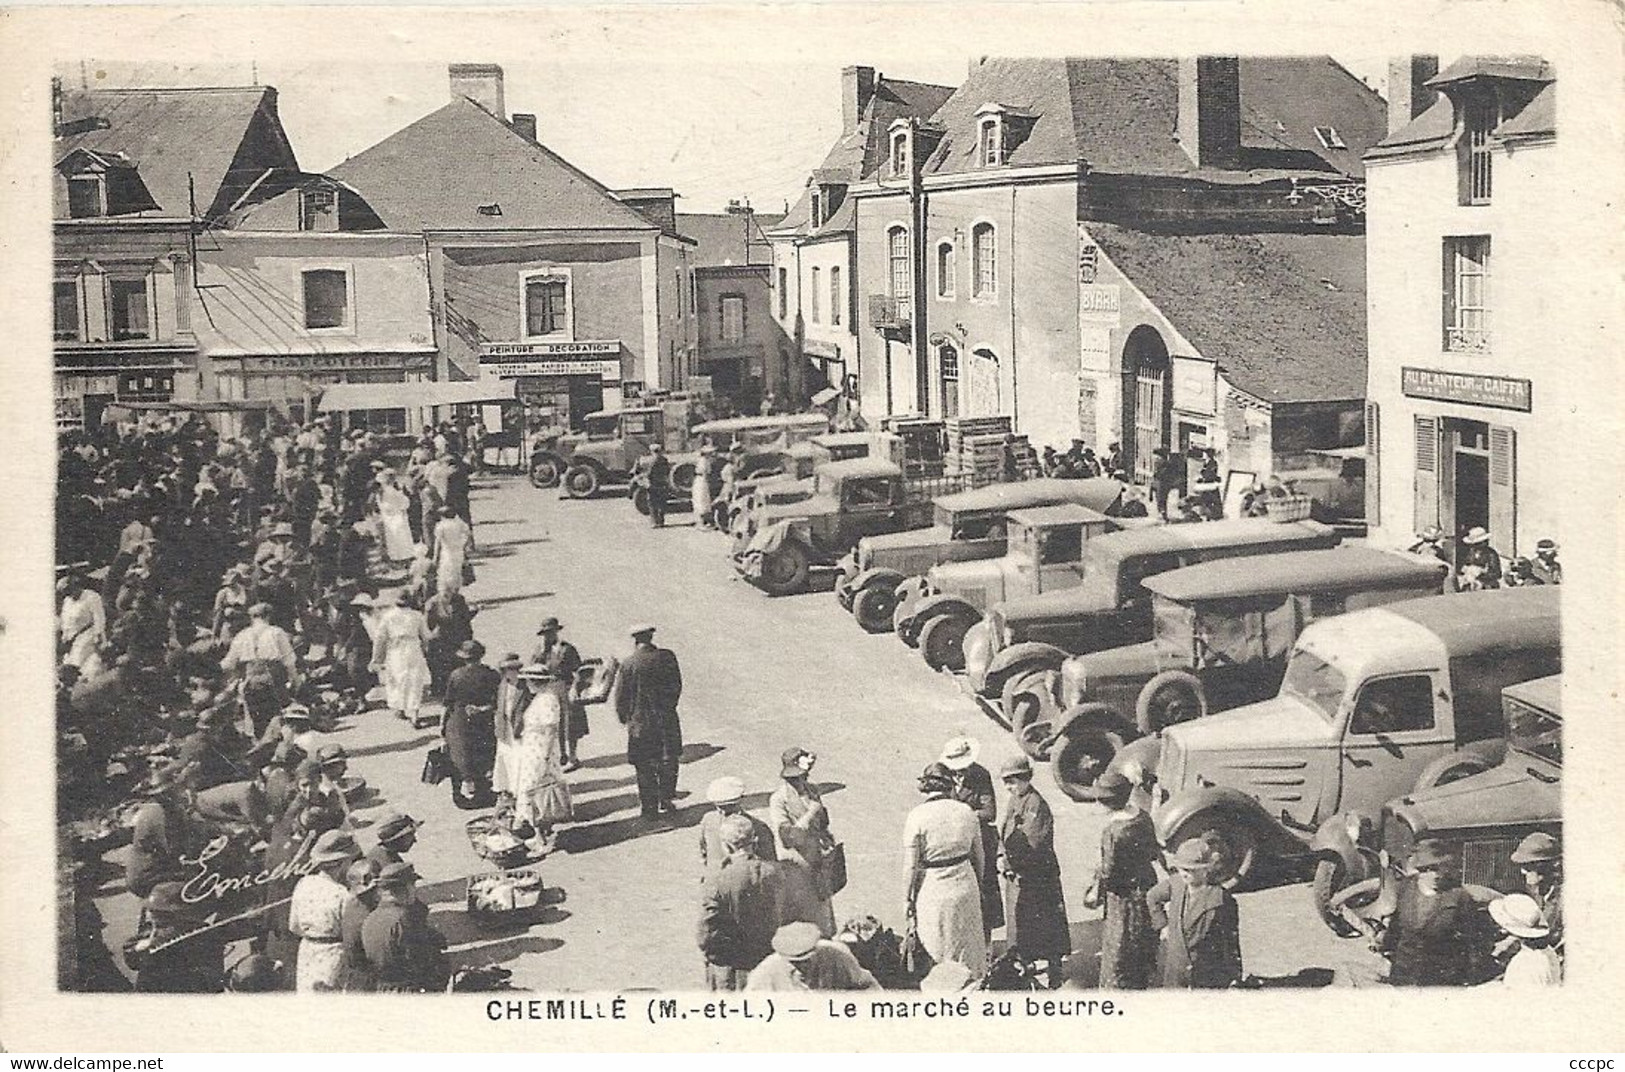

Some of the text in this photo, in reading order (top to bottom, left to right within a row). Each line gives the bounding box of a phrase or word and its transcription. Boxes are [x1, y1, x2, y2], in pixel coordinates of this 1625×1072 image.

[1083, 291, 1118, 312] BYRRH
[489, 344, 610, 354] PEINTURE DECORATION
[1420, 372, 1475, 391] PLANTEUR
